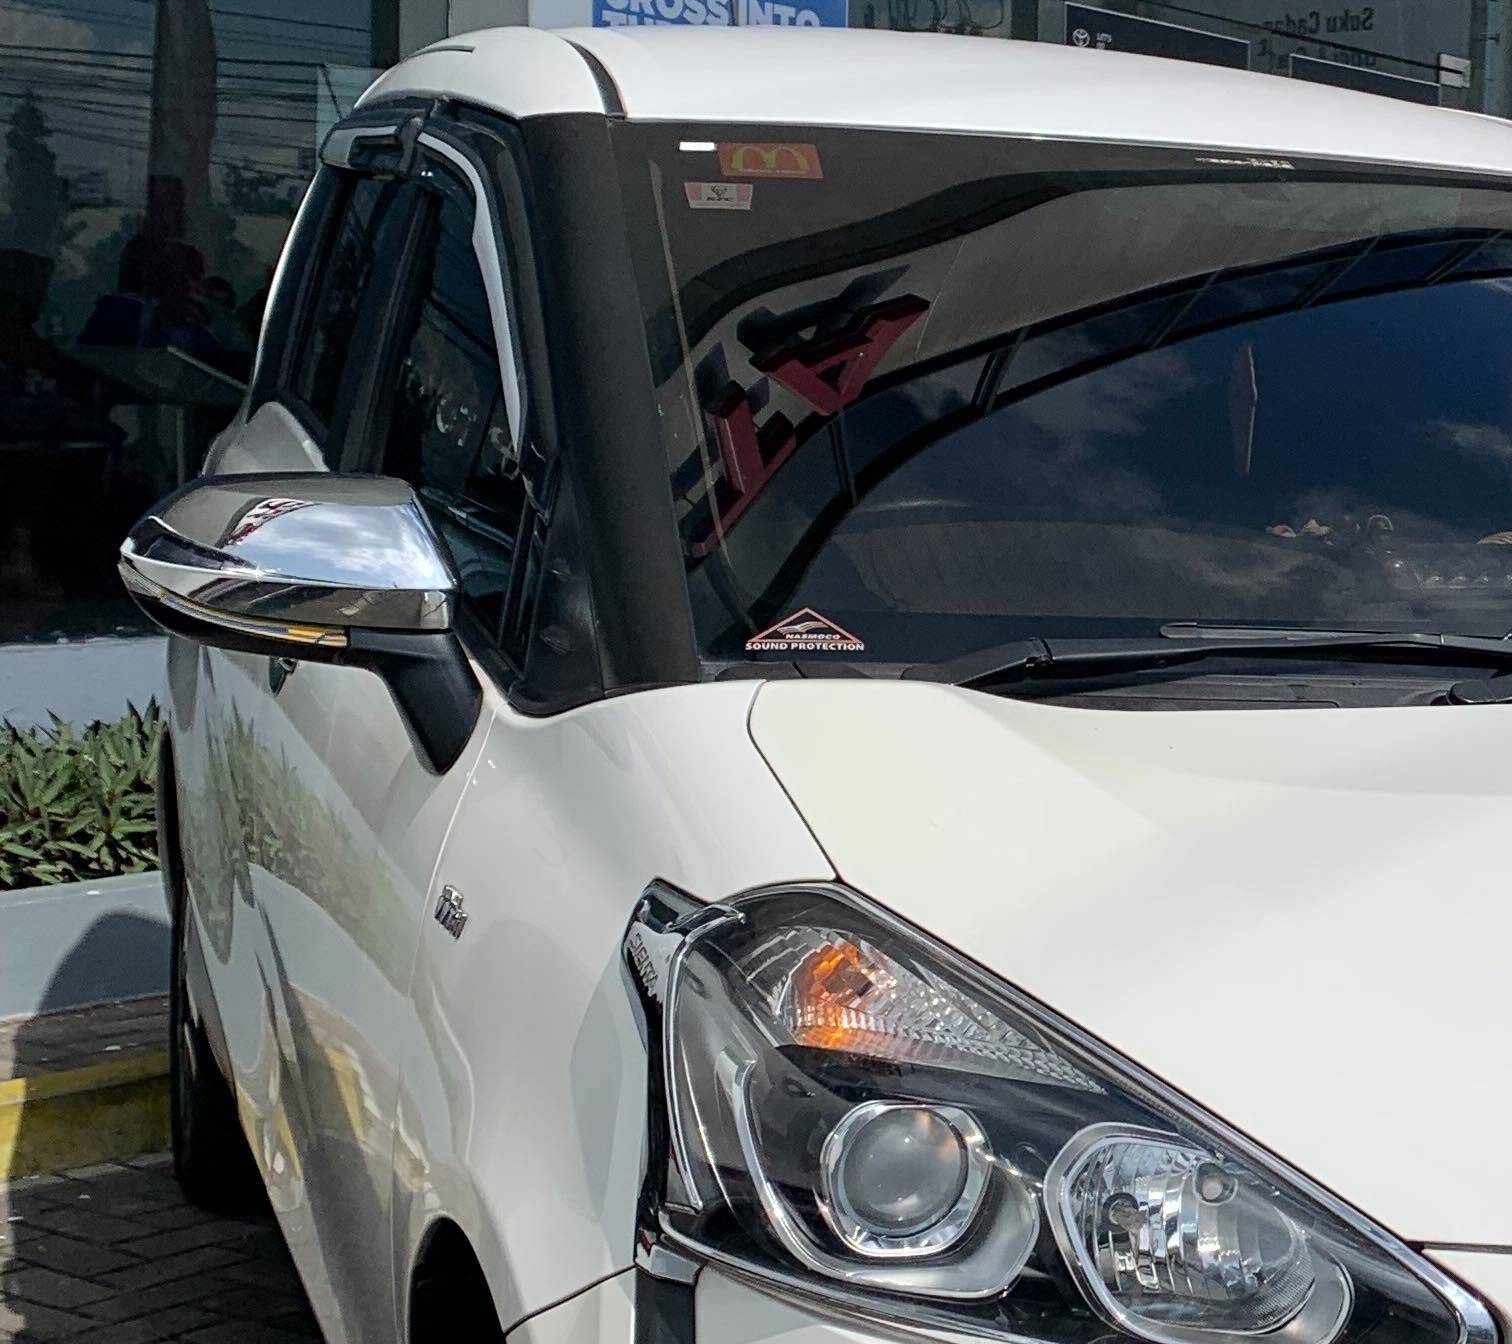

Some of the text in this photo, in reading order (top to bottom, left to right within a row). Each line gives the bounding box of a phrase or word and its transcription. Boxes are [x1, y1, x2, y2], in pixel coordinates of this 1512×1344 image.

[785, 633, 841, 641] NASMOCO
[745, 642, 865, 651] SOUND PROTECTION
